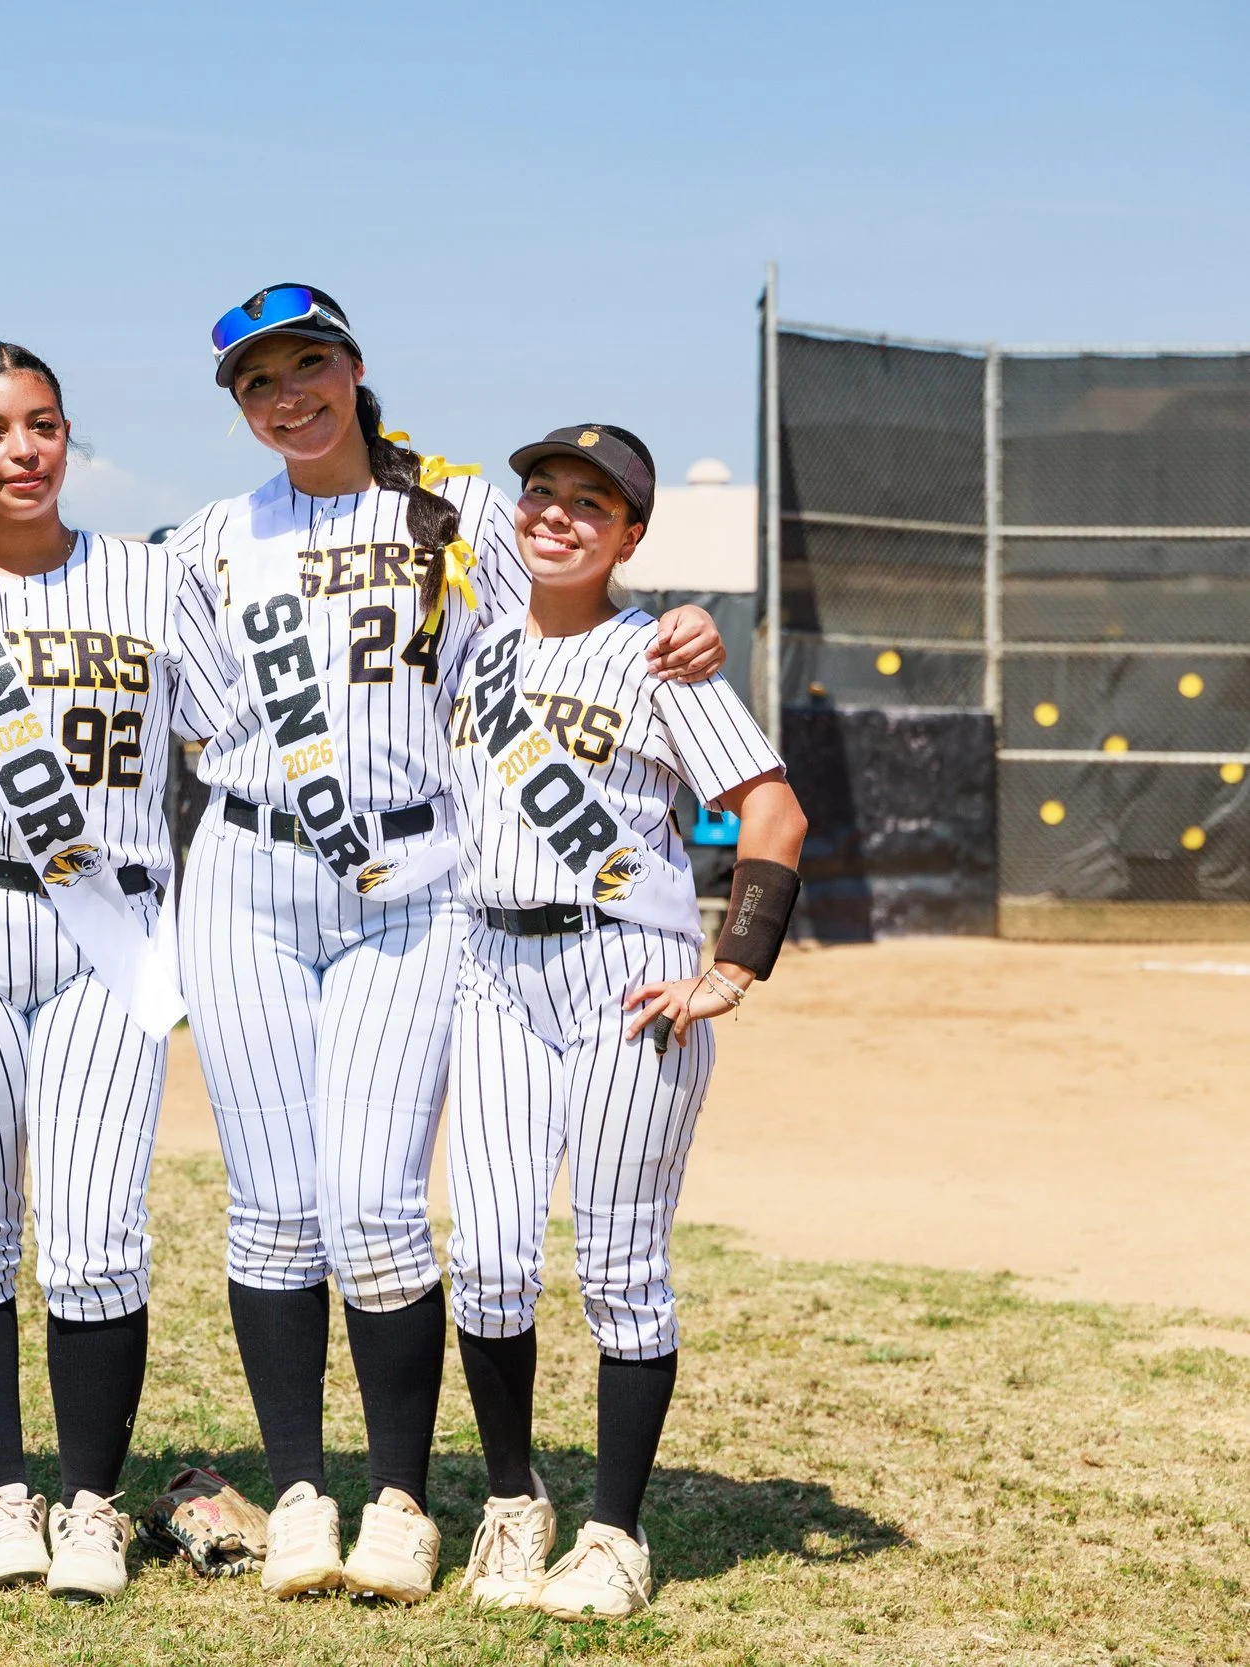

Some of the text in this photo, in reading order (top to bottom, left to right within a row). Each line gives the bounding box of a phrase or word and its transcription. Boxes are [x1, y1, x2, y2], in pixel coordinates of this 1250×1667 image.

[348, 604, 445, 686] 24
[61, 706, 145, 789] 92
[242, 593, 371, 878] SEN 2026 OR
[498, 730, 551, 786] 2026
[521, 763, 618, 876] OR
[736, 884, 759, 926] SPORTS
[745, 888, 764, 926] UNLIMITED
